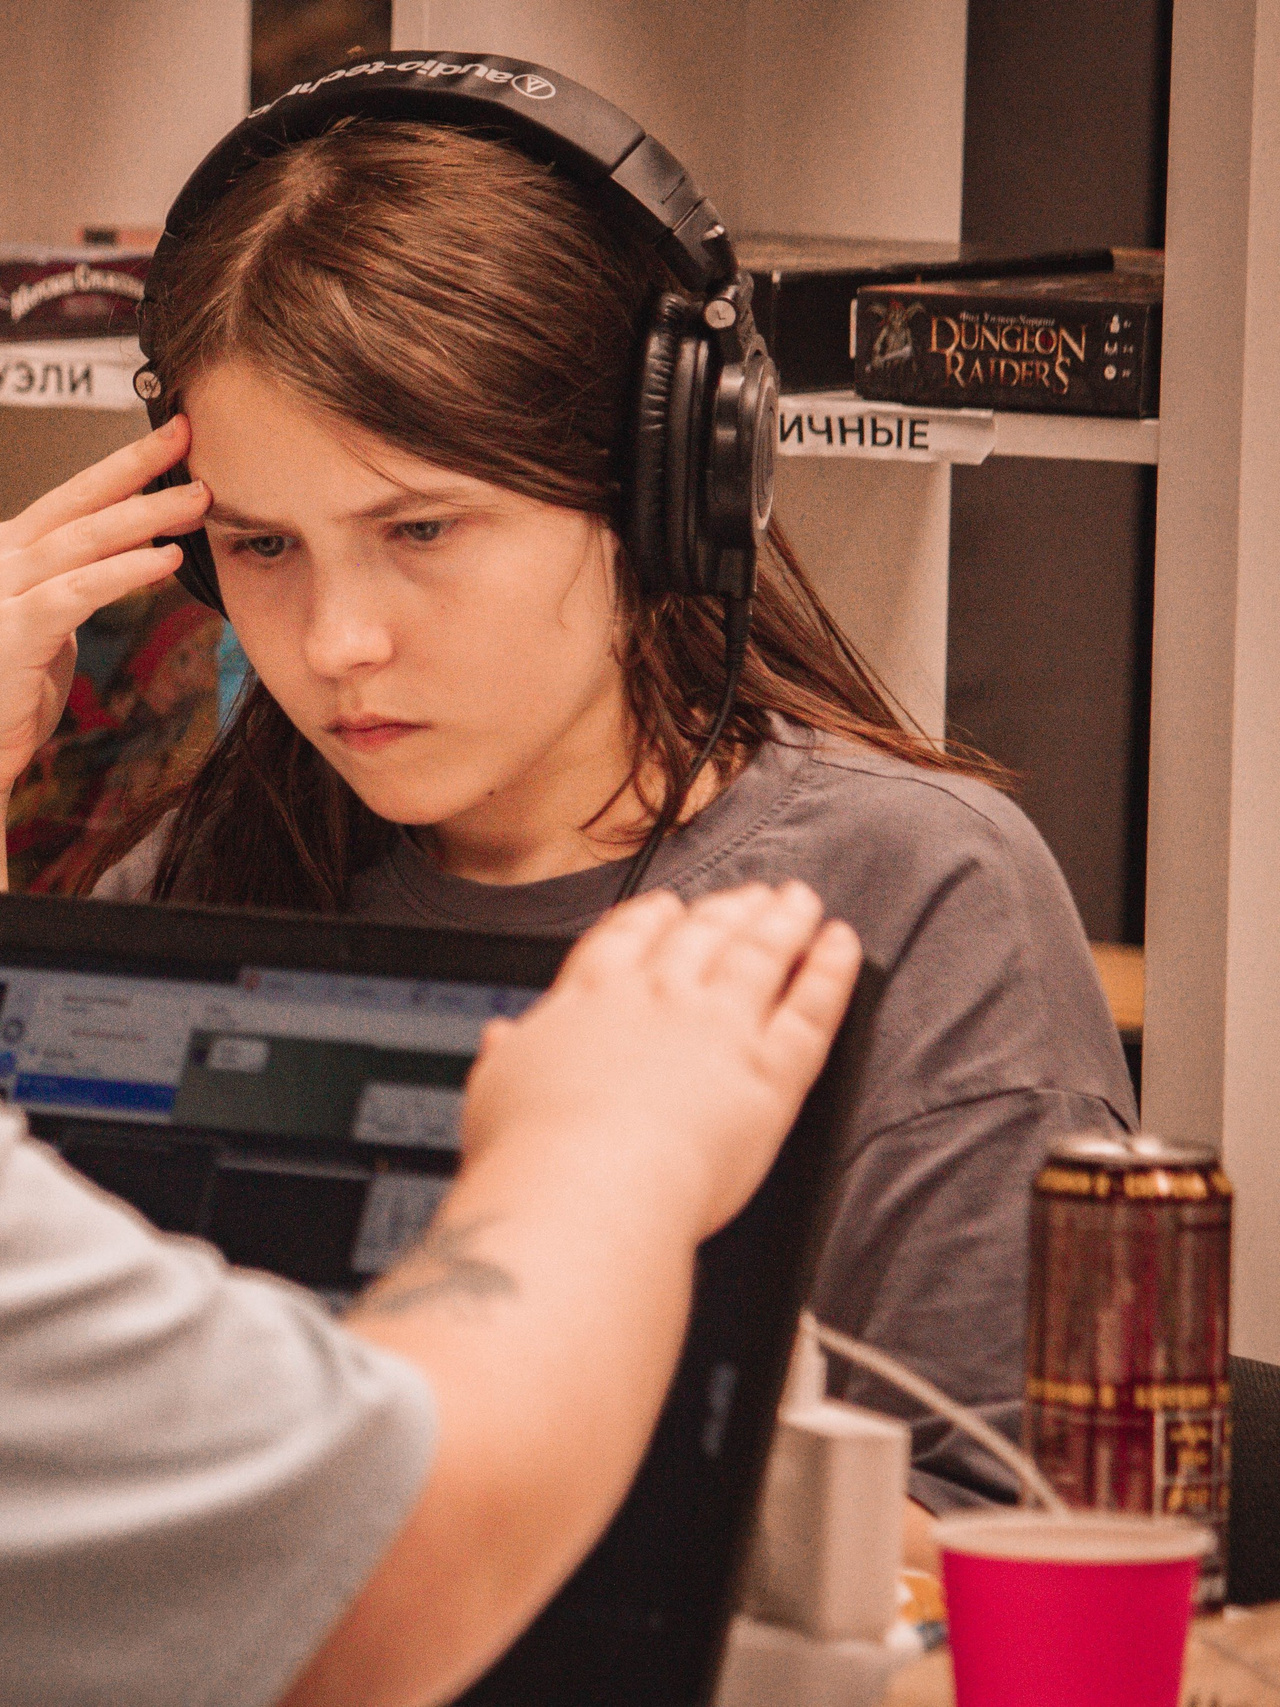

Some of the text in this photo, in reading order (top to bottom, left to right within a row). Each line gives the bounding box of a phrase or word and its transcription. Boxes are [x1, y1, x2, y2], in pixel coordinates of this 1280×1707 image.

[930, 315, 1086, 362] DUNGEON
[942, 349, 1071, 395] RAIDERS
[779, 413, 930, 450] ИЧНЫЕ
